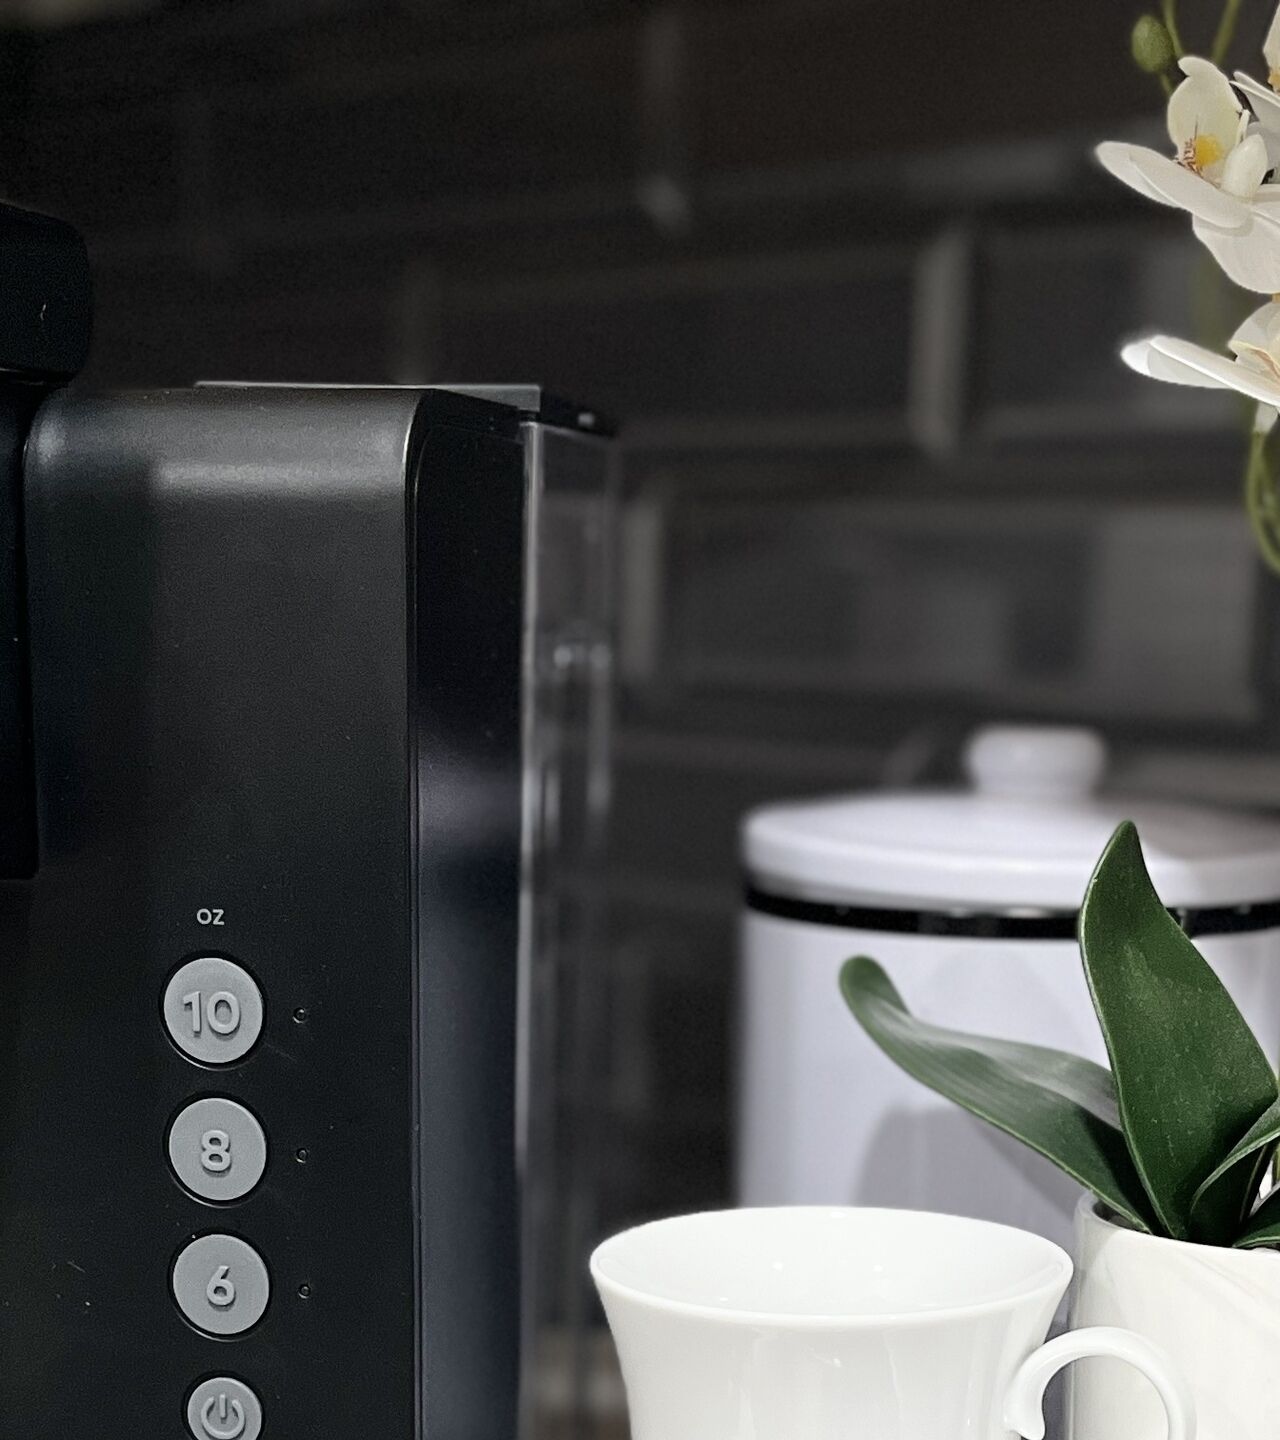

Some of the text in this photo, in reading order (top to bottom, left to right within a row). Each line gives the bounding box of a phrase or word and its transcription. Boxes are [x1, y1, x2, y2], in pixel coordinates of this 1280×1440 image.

[196, 908, 225, 926] OZ
[183, 991, 241, 1035] 10
[201, 1130, 232, 1172] 8
[206, 1265, 236, 1306] 6
